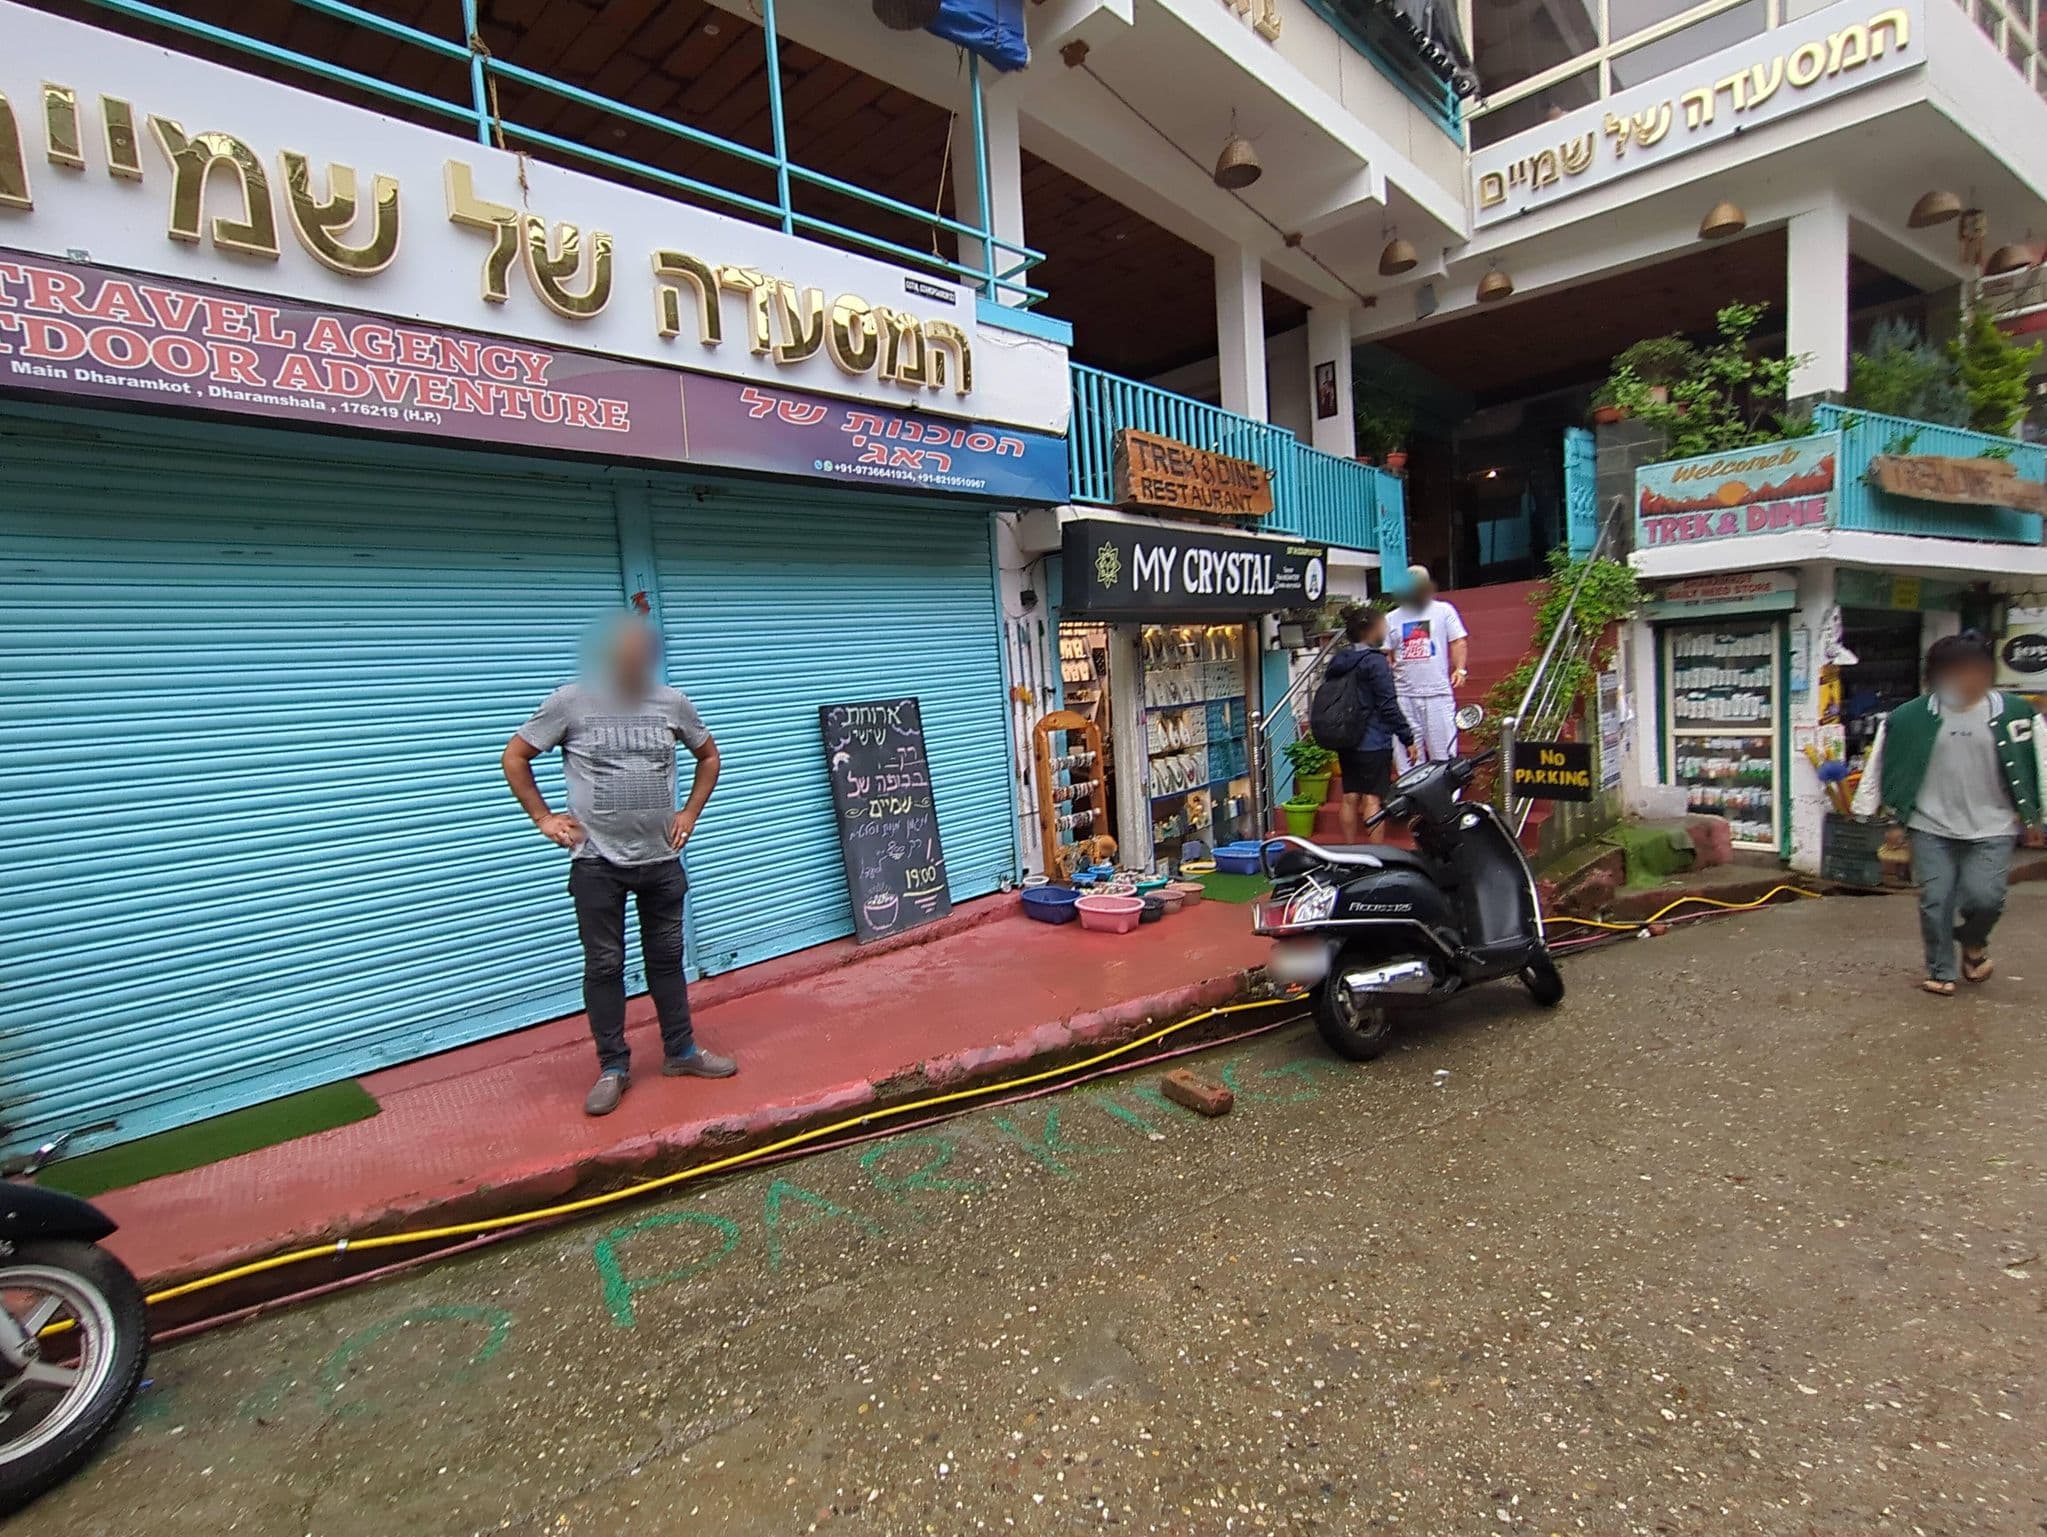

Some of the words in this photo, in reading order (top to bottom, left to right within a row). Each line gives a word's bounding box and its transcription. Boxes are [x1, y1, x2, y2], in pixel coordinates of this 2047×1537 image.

[1680, 7, 1910, 129] המסעדה
[1603, 98, 1674, 160] של
[1478, 129, 1598, 209] שמיים
[443, 160, 614, 321] של
[650, 249, 973, 396] המסעדה
[304, 316, 553, 386] AGENCY
[11, 360, 68, 379] Main
[74, 367, 192, 395] Dharamkot
[207, 385, 326, 411] Dharamshala
[340, 402, 398, 418] 176219
[403, 408, 443, 425] (H.P.)
[273, 354, 631, 432] ADVENTURE
[740, 387, 828, 426] של
[841, 411, 1025, 457] הסוכנות
[1131, 437, 1200, 479] TREK
[1215, 457, 1260, 491] DINE
[1671, 451, 1778, 485] Welcome
[1141, 477, 1253, 512] RESTAURANT
[1643, 512, 1715, 544] TREK
[1716, 512, 1740, 535] &
[1132, 543, 1177, 594] MY
[1182, 547, 1276, 596] CRYSTAL
[841, 706, 902, 727] ארוחת
[852, 728, 887, 746] שישי
[847, 770, 870, 798] של
[1514, 768, 1590, 787] PARKING
